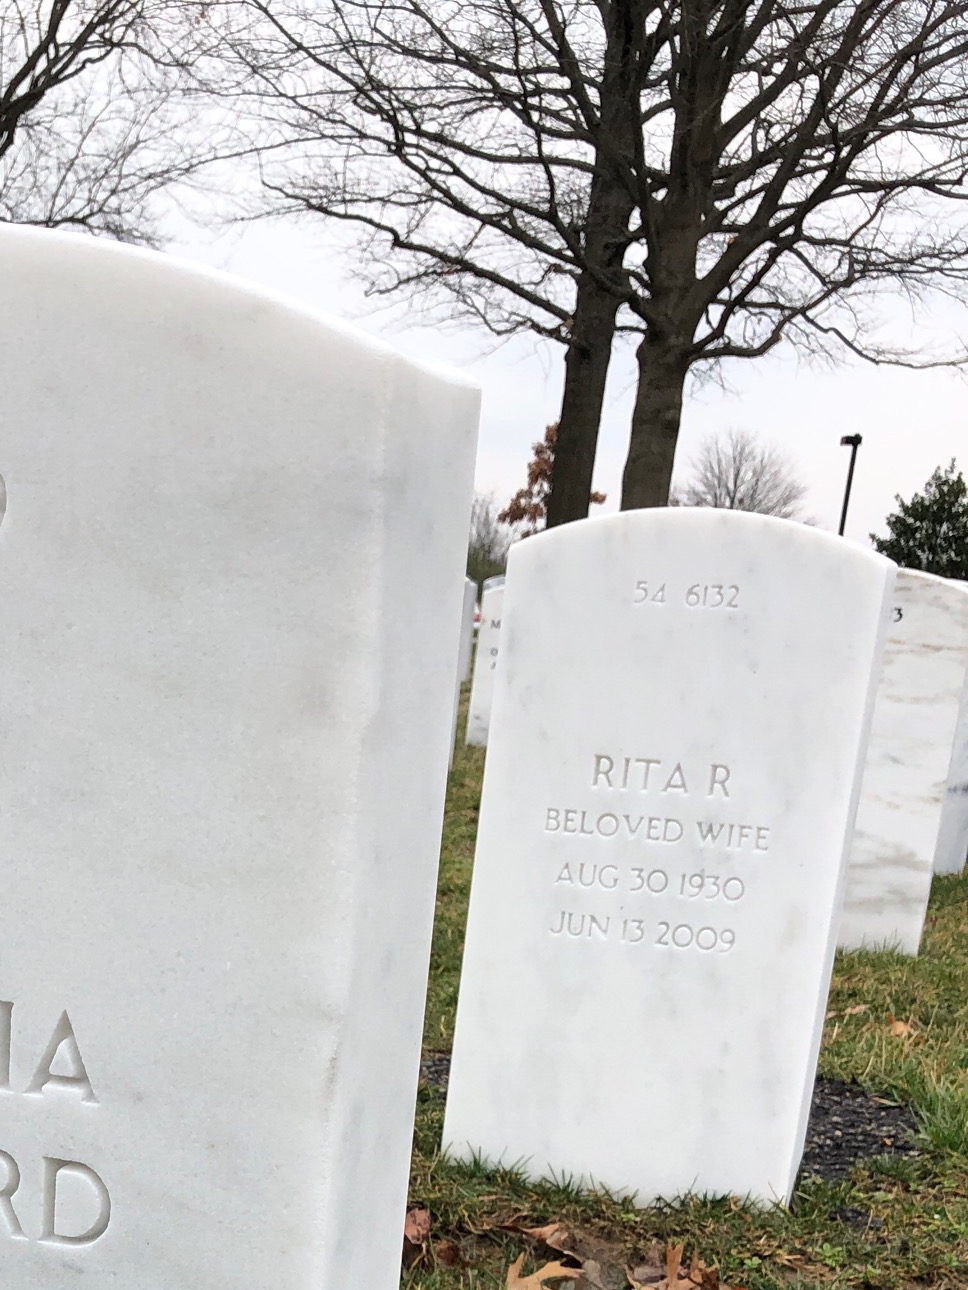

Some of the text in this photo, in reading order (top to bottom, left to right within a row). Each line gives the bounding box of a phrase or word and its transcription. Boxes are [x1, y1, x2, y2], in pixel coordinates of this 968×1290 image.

[633, 581, 740, 609] 54 6132
[591, 754, 731, 798] RITA R
[545, 809, 770, 851] BELOVED WIFE
[554, 863, 745, 901] AUG 30 1930
[549, 911, 736, 954] JUN 13 2009
